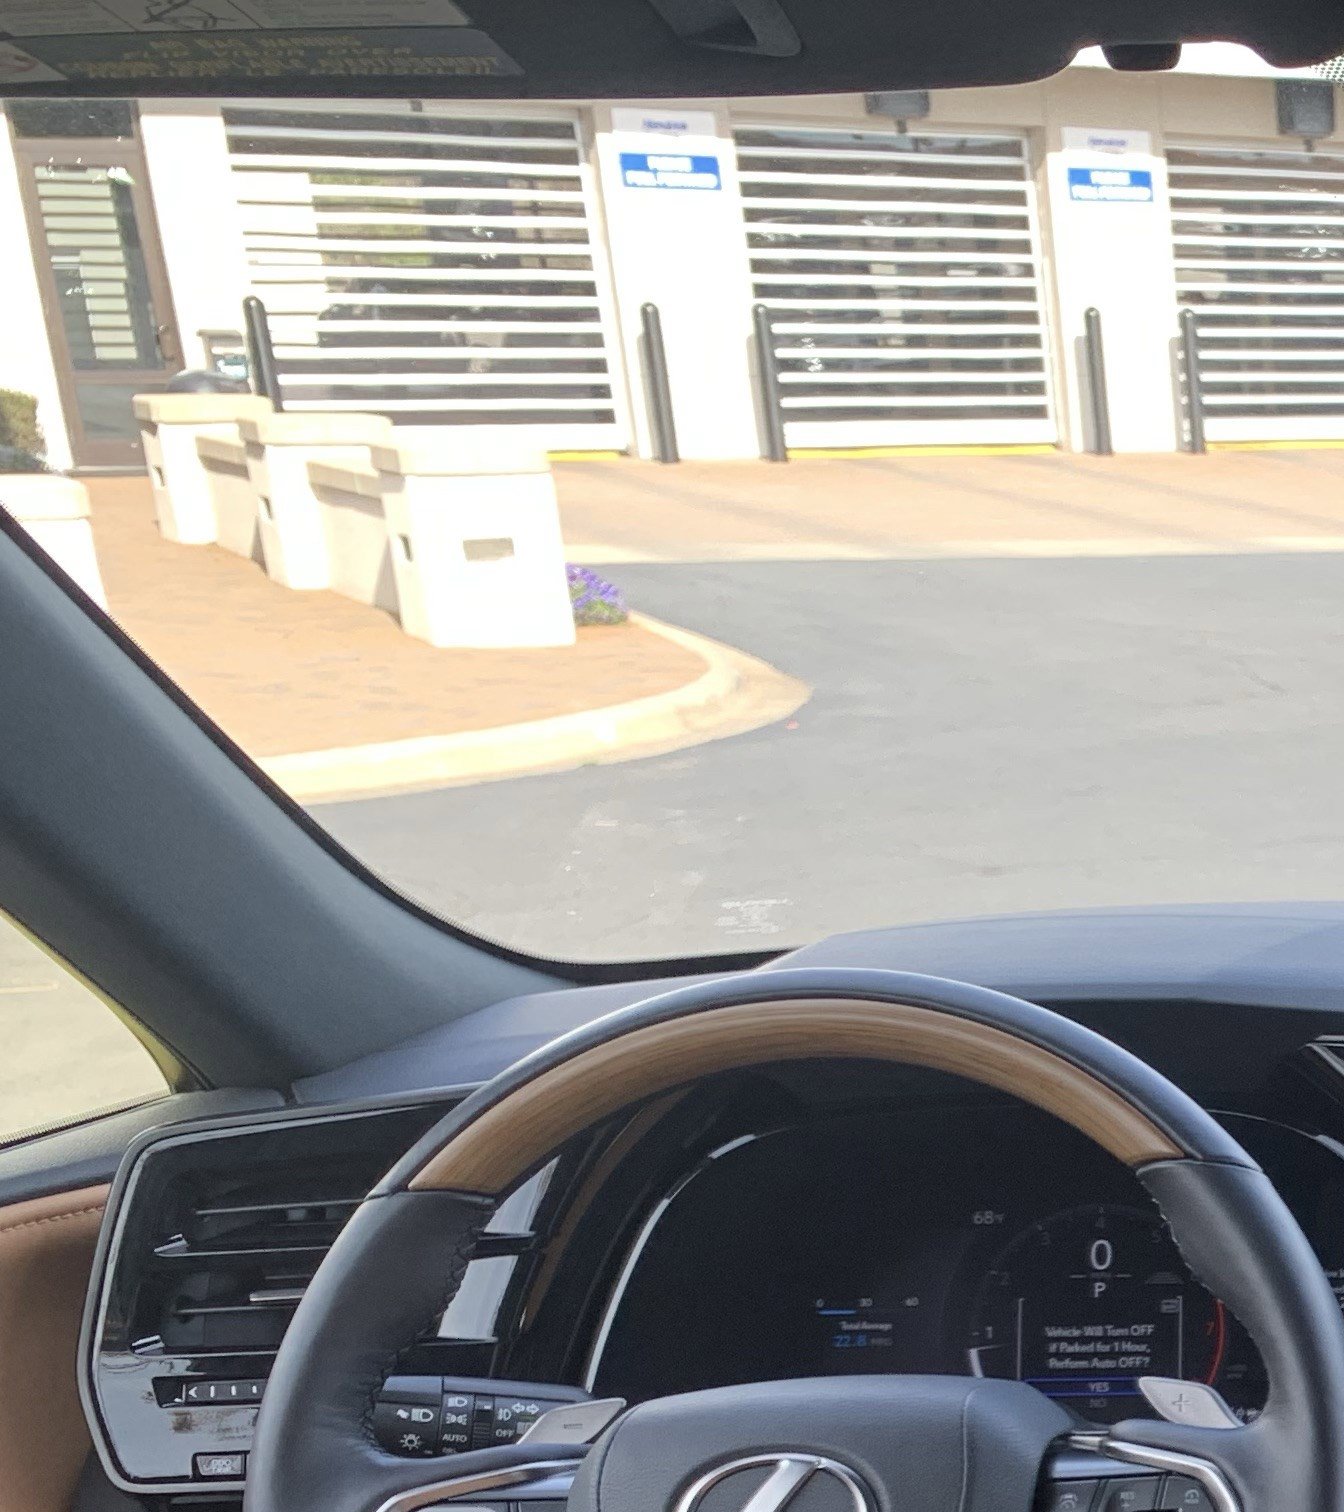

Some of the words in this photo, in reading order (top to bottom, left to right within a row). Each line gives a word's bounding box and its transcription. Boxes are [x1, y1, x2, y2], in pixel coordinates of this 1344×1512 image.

[1090, 1238, 1112, 1270] 0
[1093, 1282, 1107, 1298] P
[1044, 1325, 1081, 1337] Vehicle
[1083, 1325, 1103, 1336] Will
[1104, 1324, 1128, 1336] Turn
[1130, 1324, 1155, 1336] OFF
[1059, 1341, 1094, 1353] Parked
[1096, 1341, 1111, 1352] for
[1048, 1357, 1089, 1369] Perform
[1090, 1357, 1117, 1369] Auto
[1119, 1356, 1151, 1369] OFF?
[1089, 1381, 1110, 1393] YES
[442, 1433, 468, 1443] AUTO
[495, 1428, 515, 1438] OFF
